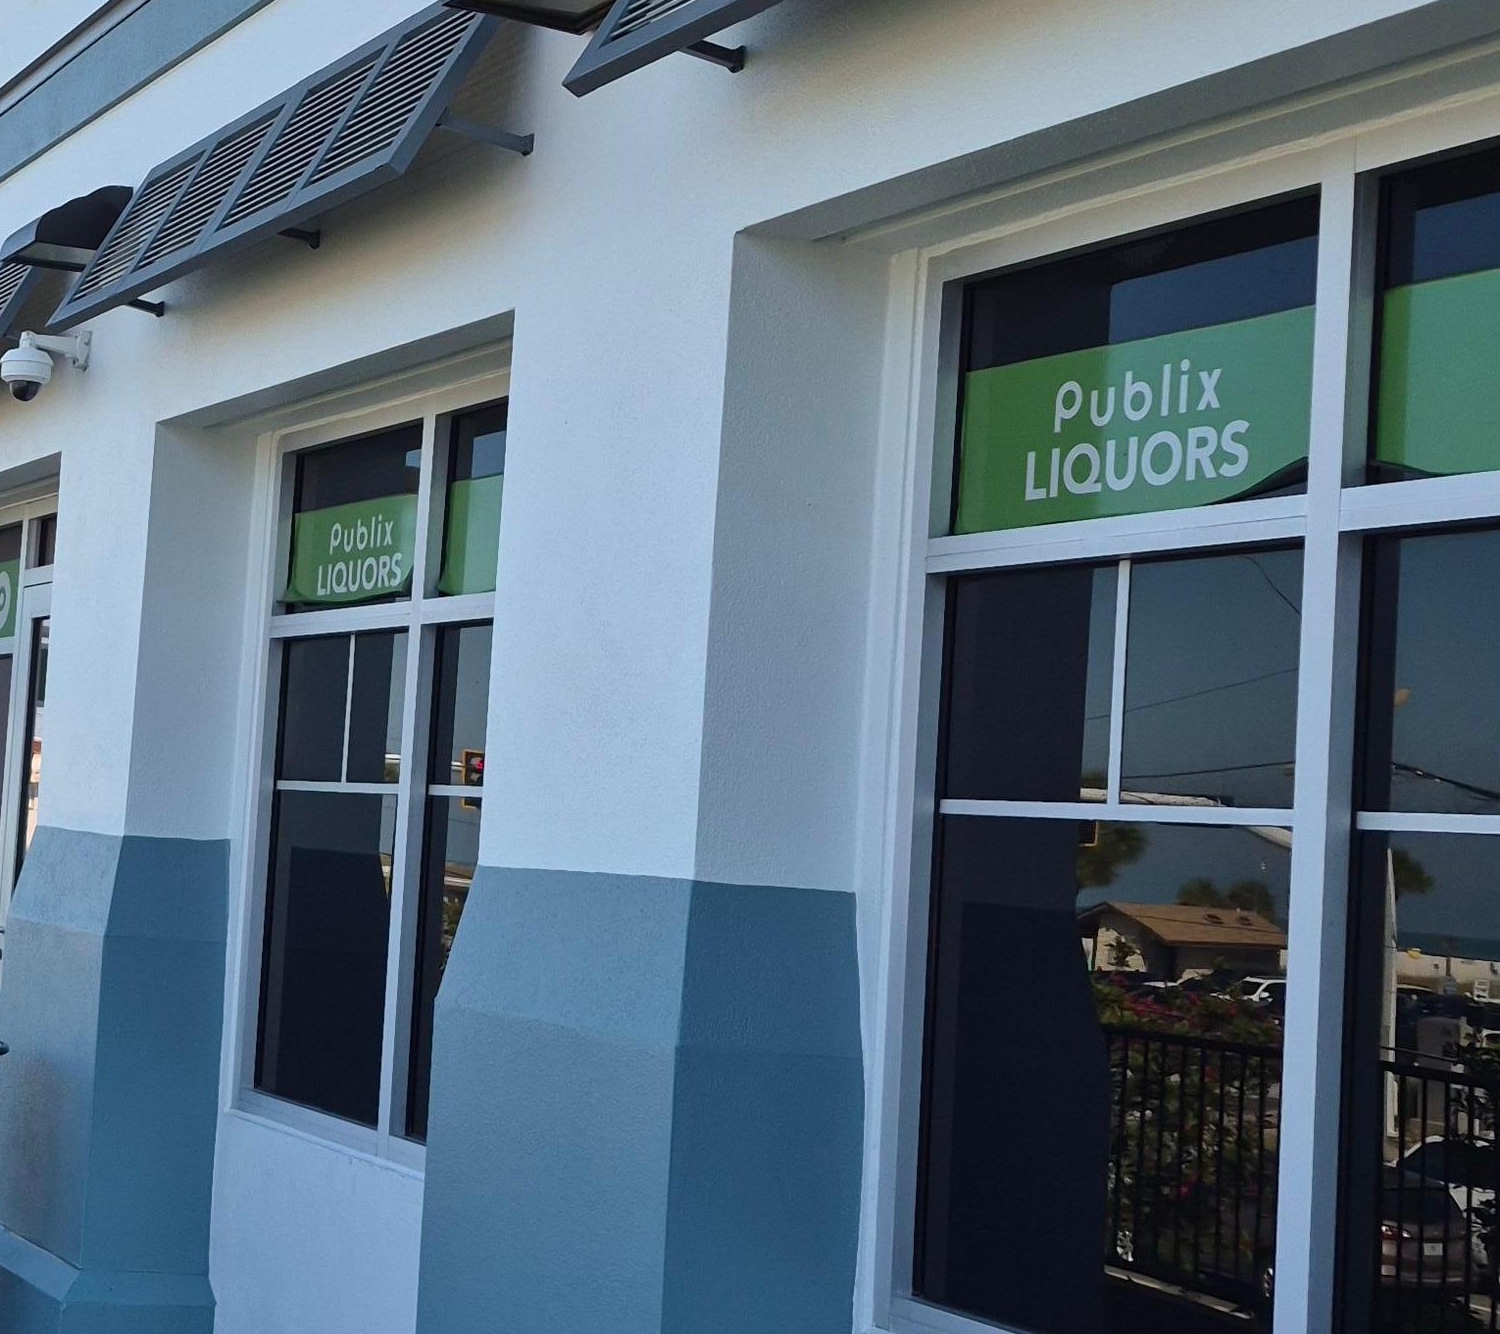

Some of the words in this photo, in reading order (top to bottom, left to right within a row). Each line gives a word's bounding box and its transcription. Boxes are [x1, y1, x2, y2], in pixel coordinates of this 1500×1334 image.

[1054, 359, 1222, 433] Publix
[1024, 419, 1250, 501] LIQUORS
[329, 514, 394, 553] Publix
[316, 553, 402, 596] LIQUORS
